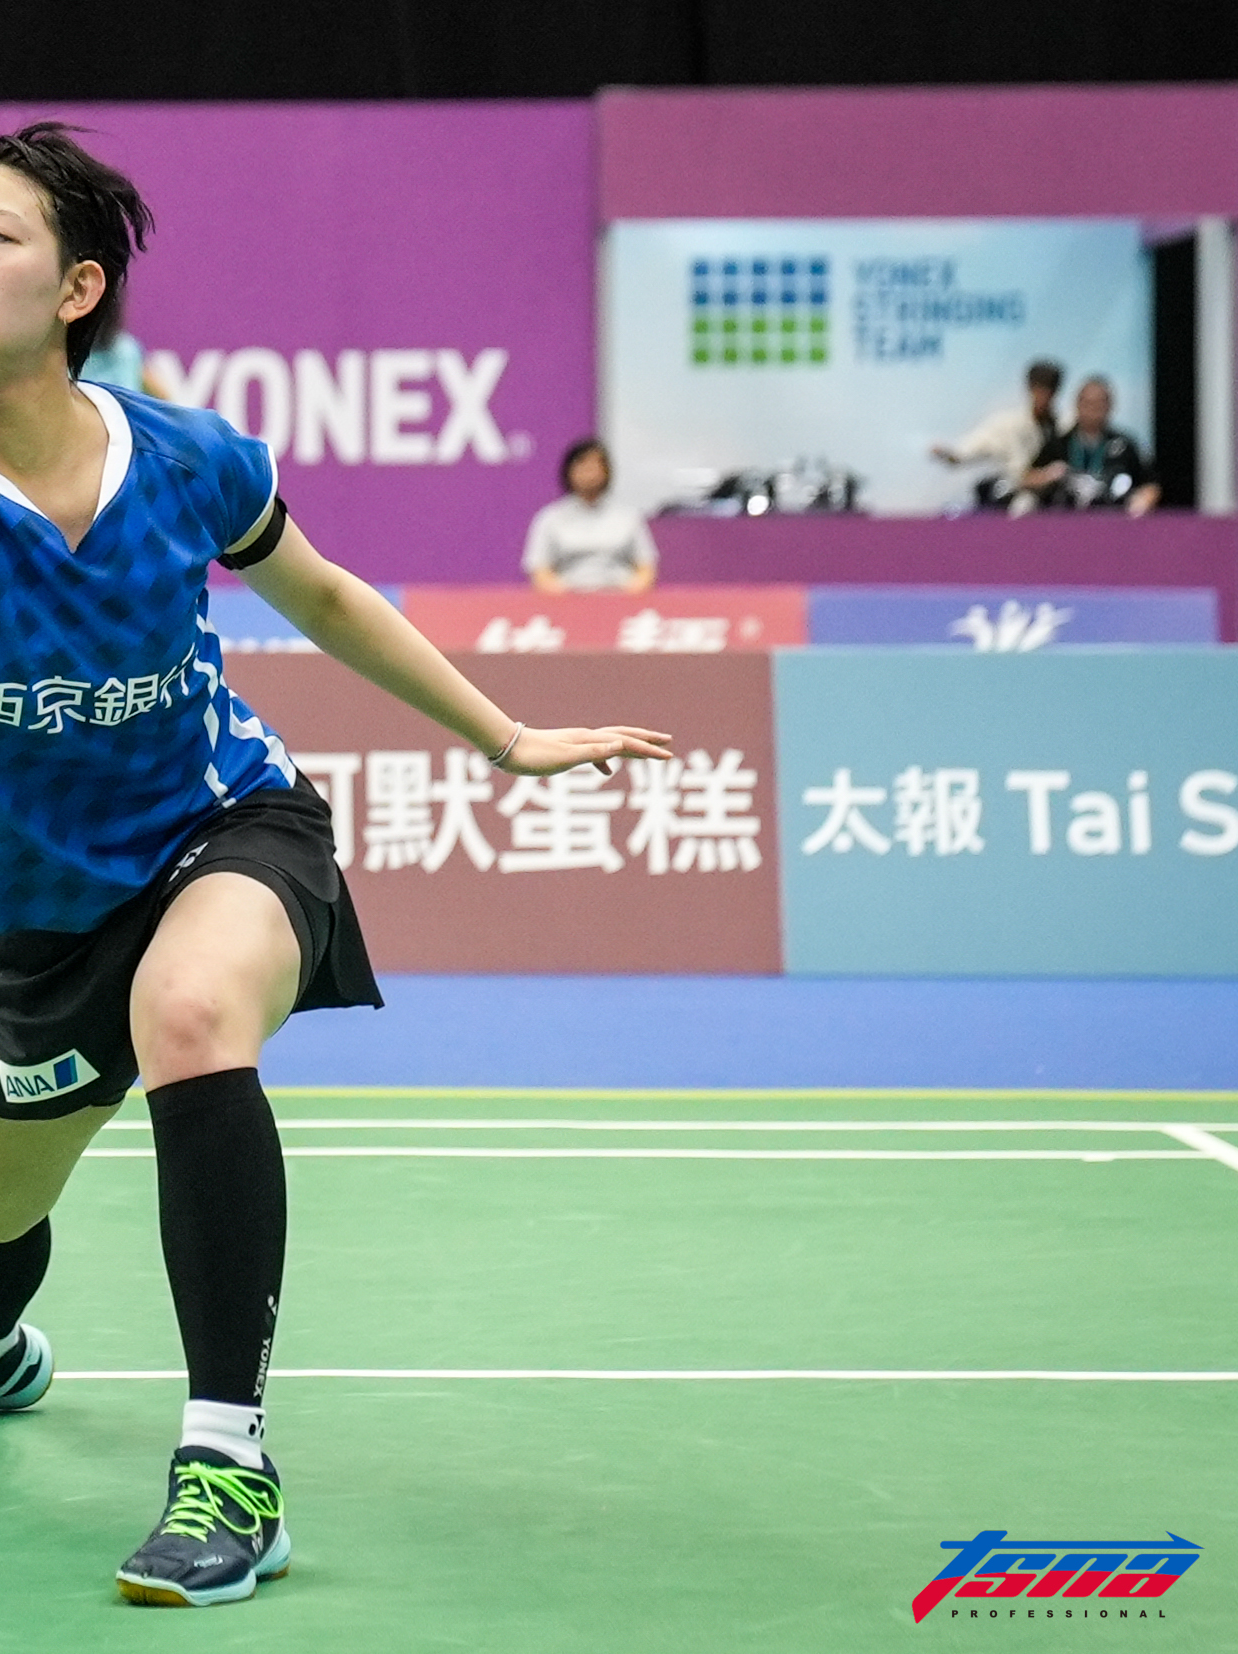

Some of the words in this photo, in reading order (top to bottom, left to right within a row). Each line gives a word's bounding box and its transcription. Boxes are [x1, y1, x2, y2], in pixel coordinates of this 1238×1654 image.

[854, 329, 944, 362] TEAM
[801, 767, 986, 856] 太報
[1004, 769, 1152, 856] Tai
[6, 1074, 56, 1097] ANA
[253, 1337, 272, 1398] YONEX
